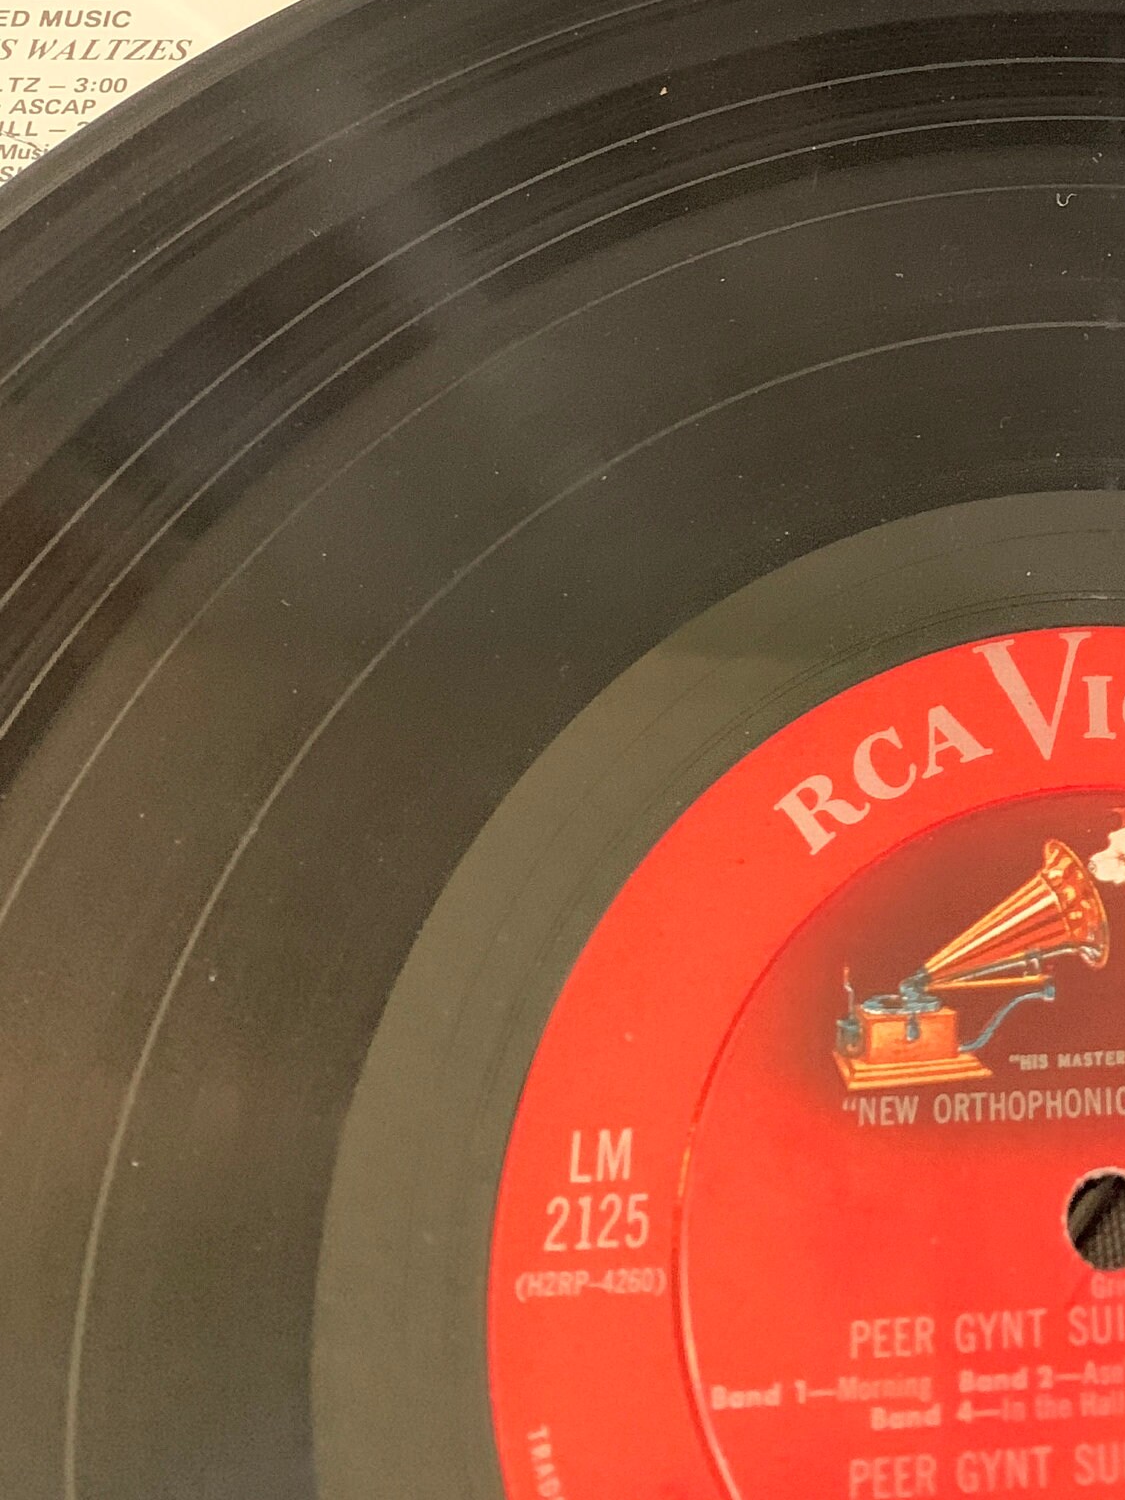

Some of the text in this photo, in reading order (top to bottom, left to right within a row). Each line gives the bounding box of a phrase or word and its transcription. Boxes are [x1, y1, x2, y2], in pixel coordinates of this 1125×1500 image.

[39, 10, 132, 29] MUSIC
[27, 38, 193, 61] WALTZES
[0, 77, 41, 93] TZ
[73, 77, 128, 93] 3:00
[8, 98, 97, 115] ASCAP
[773, 704, 994, 856] RCA
[570, 1127, 632, 1183] LM
[544, 1193, 649, 1251] 2125
[850, 1316, 935, 1359] PEER
[954, 1308, 1048, 1353] GYNT
[711, 1383, 782, 1410] Band
[959, 1366, 1029, 1393] Band
[870, 1403, 942, 1431] Band
[526, 1422, 566, 1500] TRAD
[848, 1453, 938, 1500] PEER
[955, 1445, 1053, 1494] GYNT
